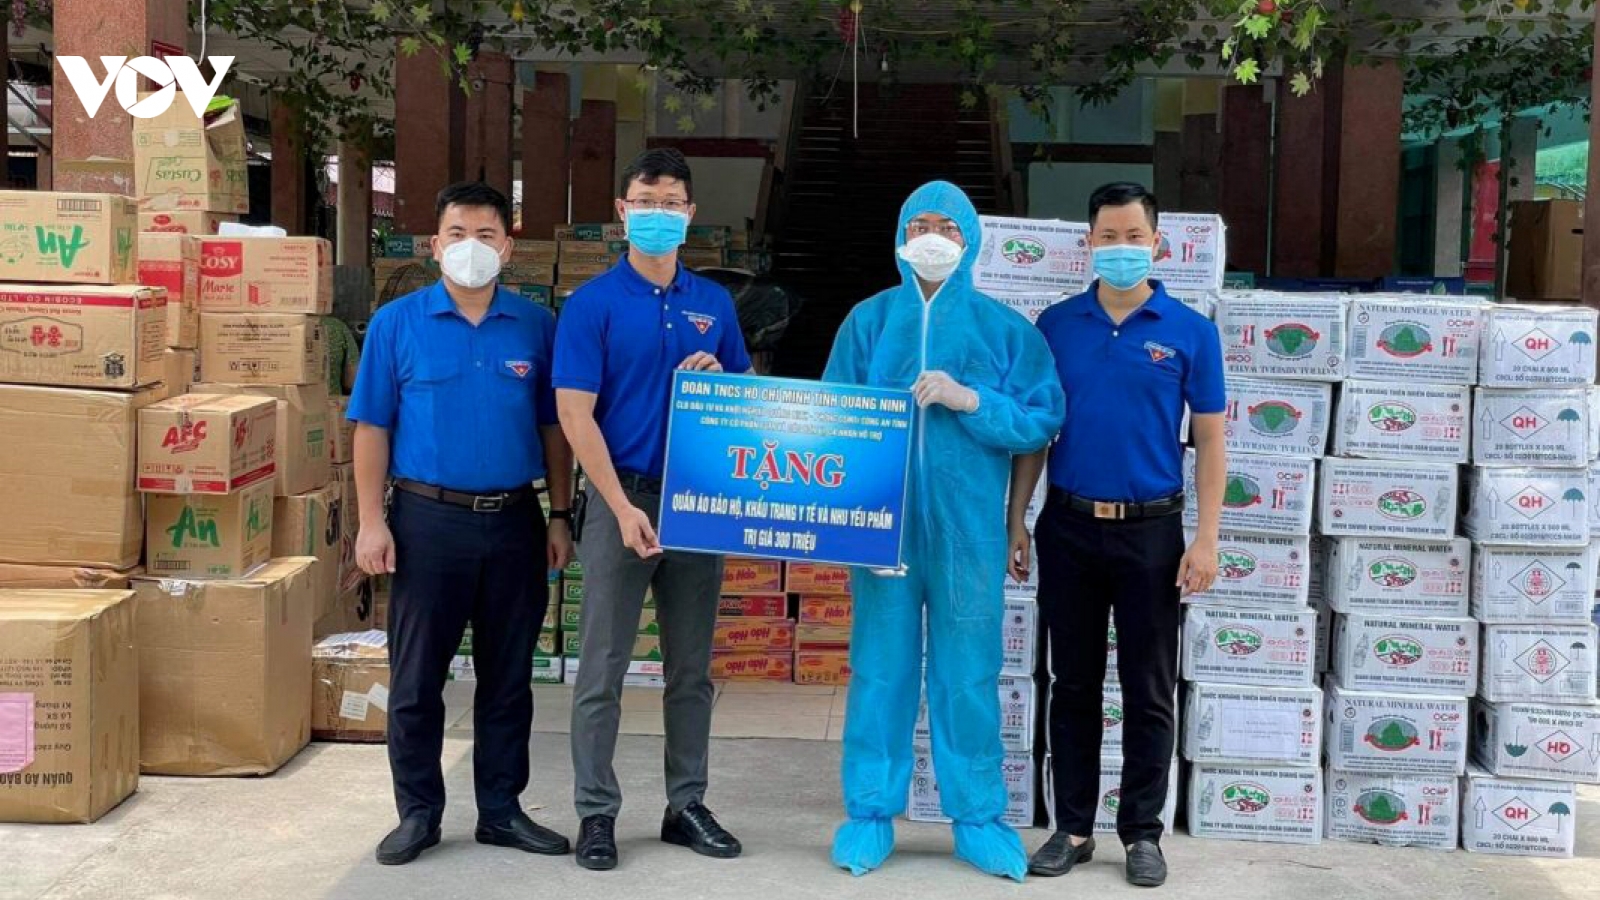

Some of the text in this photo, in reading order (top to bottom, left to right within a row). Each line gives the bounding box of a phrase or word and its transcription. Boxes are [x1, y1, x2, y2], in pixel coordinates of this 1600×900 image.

[1525, 337, 1549, 350] QH
[714, 384, 740, 398] TNCS
[780, 390, 811, 405] MINH
[880, 398, 907, 413] NINH
[1512, 416, 1537, 428] QH
[728, 439, 846, 490] TẶNG
[1518, 496, 1542, 508] QH
[770, 500, 796, 520] TRANG
[798, 504, 804, 522] Y
[166, 505, 220, 548] An
[774, 531, 790, 548] 300
[1393, 544, 1426, 552] MINERAL
[1428, 545, 1453, 553] WATER
[1205, 610, 1299, 622] NATURAL MINERAL WATER
[1364, 620, 1397, 628] NATURAL
[1399, 622, 1433, 630] MINERAL
[1344, 699, 1457, 711] NATURAL MINERAL WATER
[1547, 741, 1570, 755] QH
[1505, 806, 1528, 820] QH
